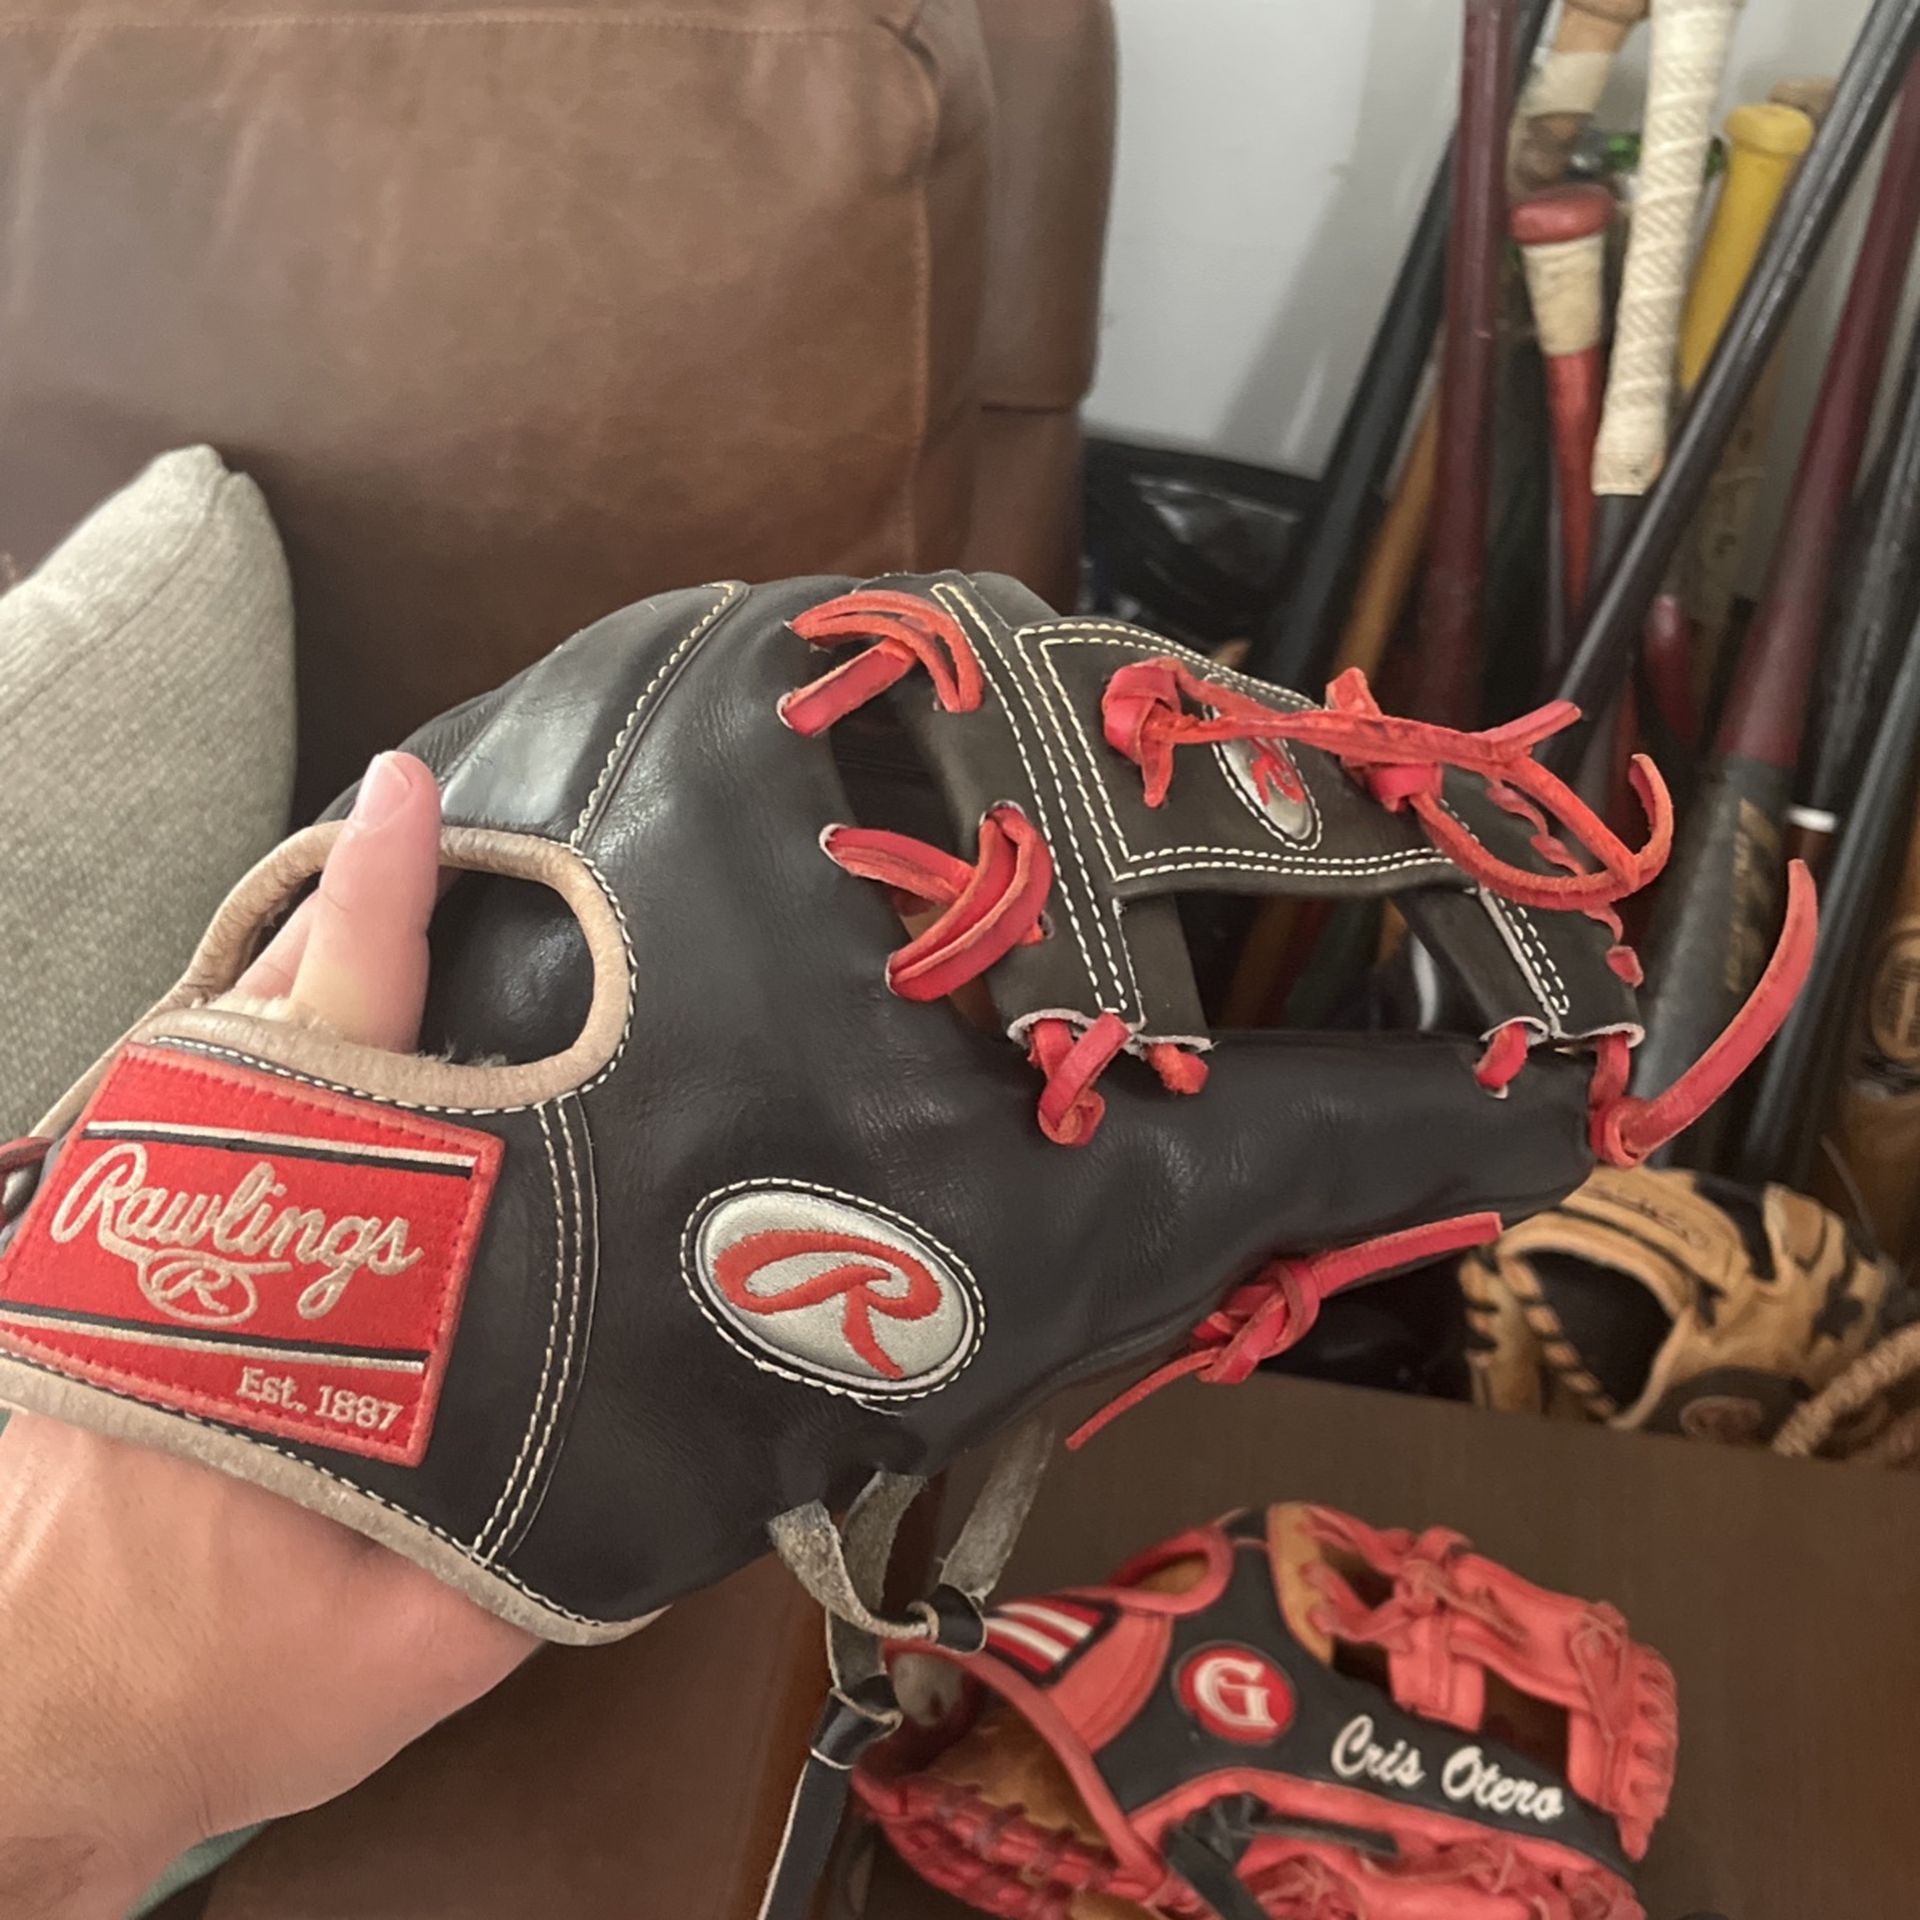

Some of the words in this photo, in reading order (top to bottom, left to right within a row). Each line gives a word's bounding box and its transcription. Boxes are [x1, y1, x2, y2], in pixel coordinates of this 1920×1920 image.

[50, 1142, 424, 1320] Rawlings
[713, 1229, 943, 1380] R
[236, 1366, 306, 1414] Est.
[315, 1384, 405, 1431] 1887
[1193, 1656, 1279, 1729] G
[1331, 1714, 1427, 1788] Cris
[1441, 1745, 1565, 1822] Otero
